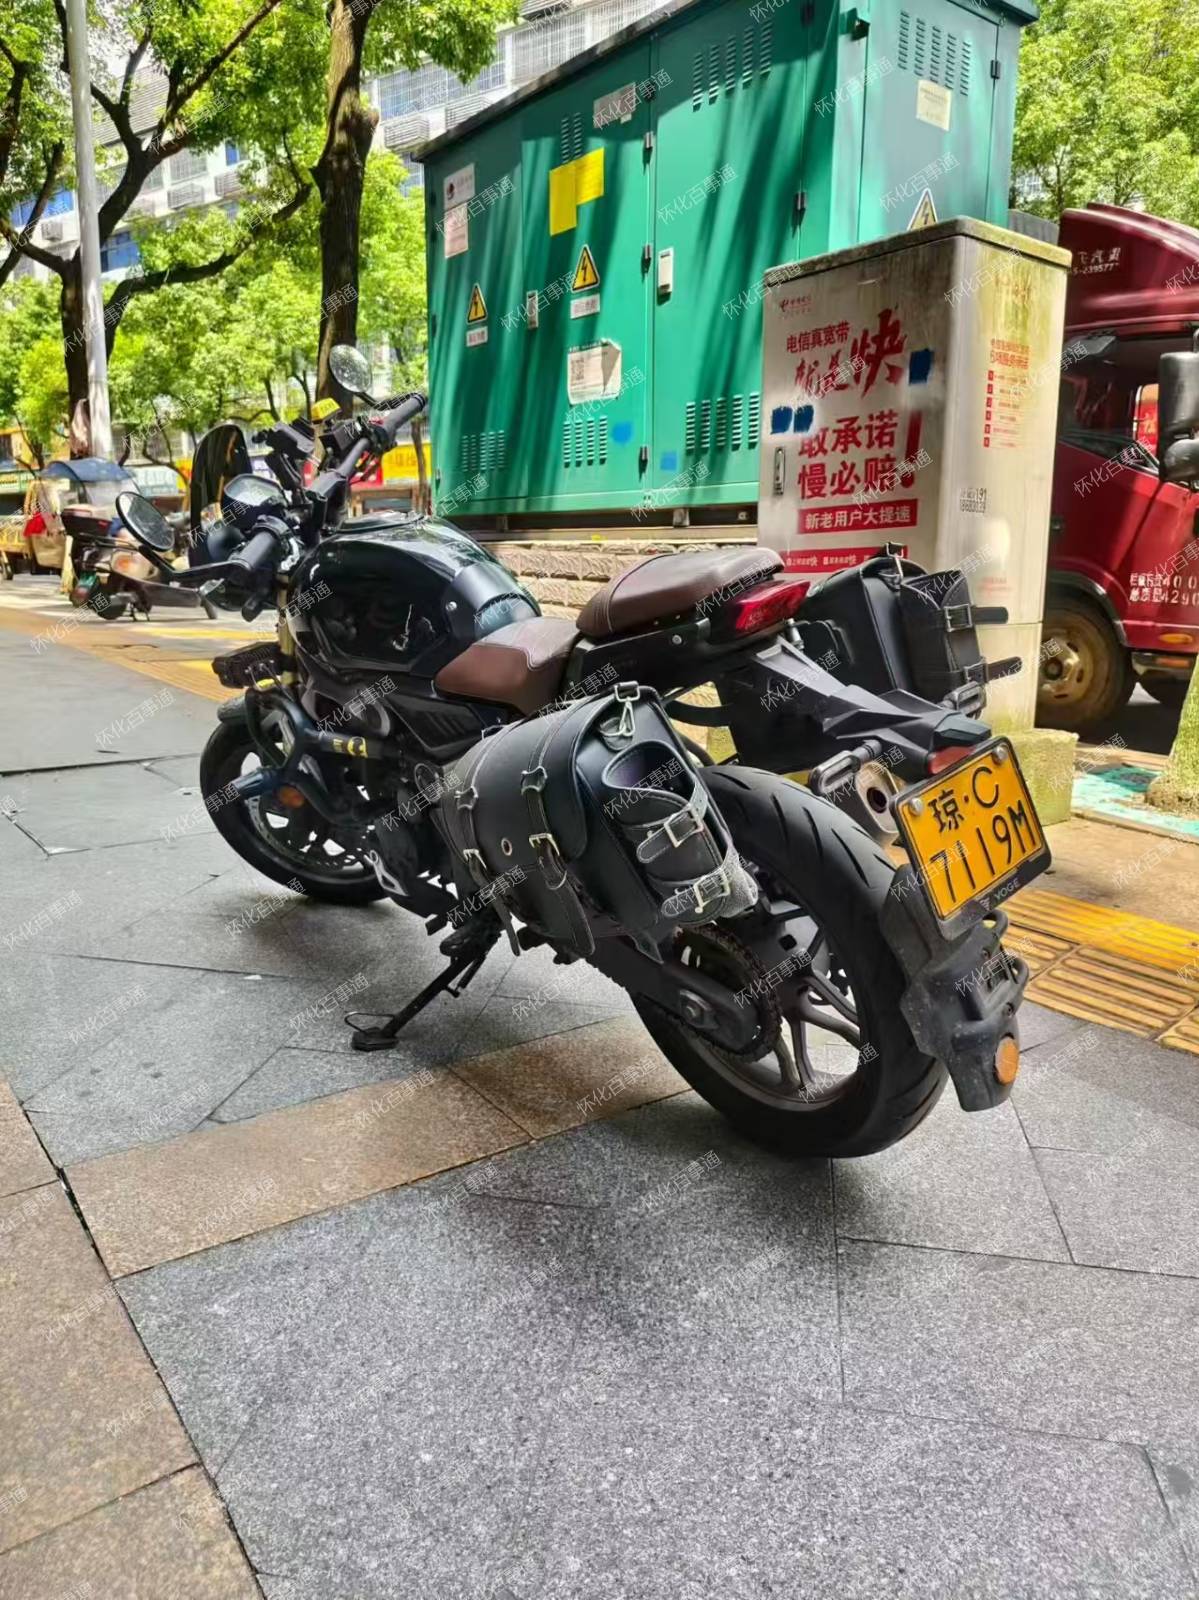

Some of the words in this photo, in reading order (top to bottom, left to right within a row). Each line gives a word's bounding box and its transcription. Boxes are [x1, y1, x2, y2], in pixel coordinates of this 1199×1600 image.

[787, 320, 850, 353] 电信真宽带
[799, 409, 899, 458] 敢承诺
[797, 453, 898, 499] 慢必赔
[805, 505, 912, 529] 新老用户大提速
[927, 766, 999, 833] 琼·C
[930, 800, 1036, 902] 7119M
